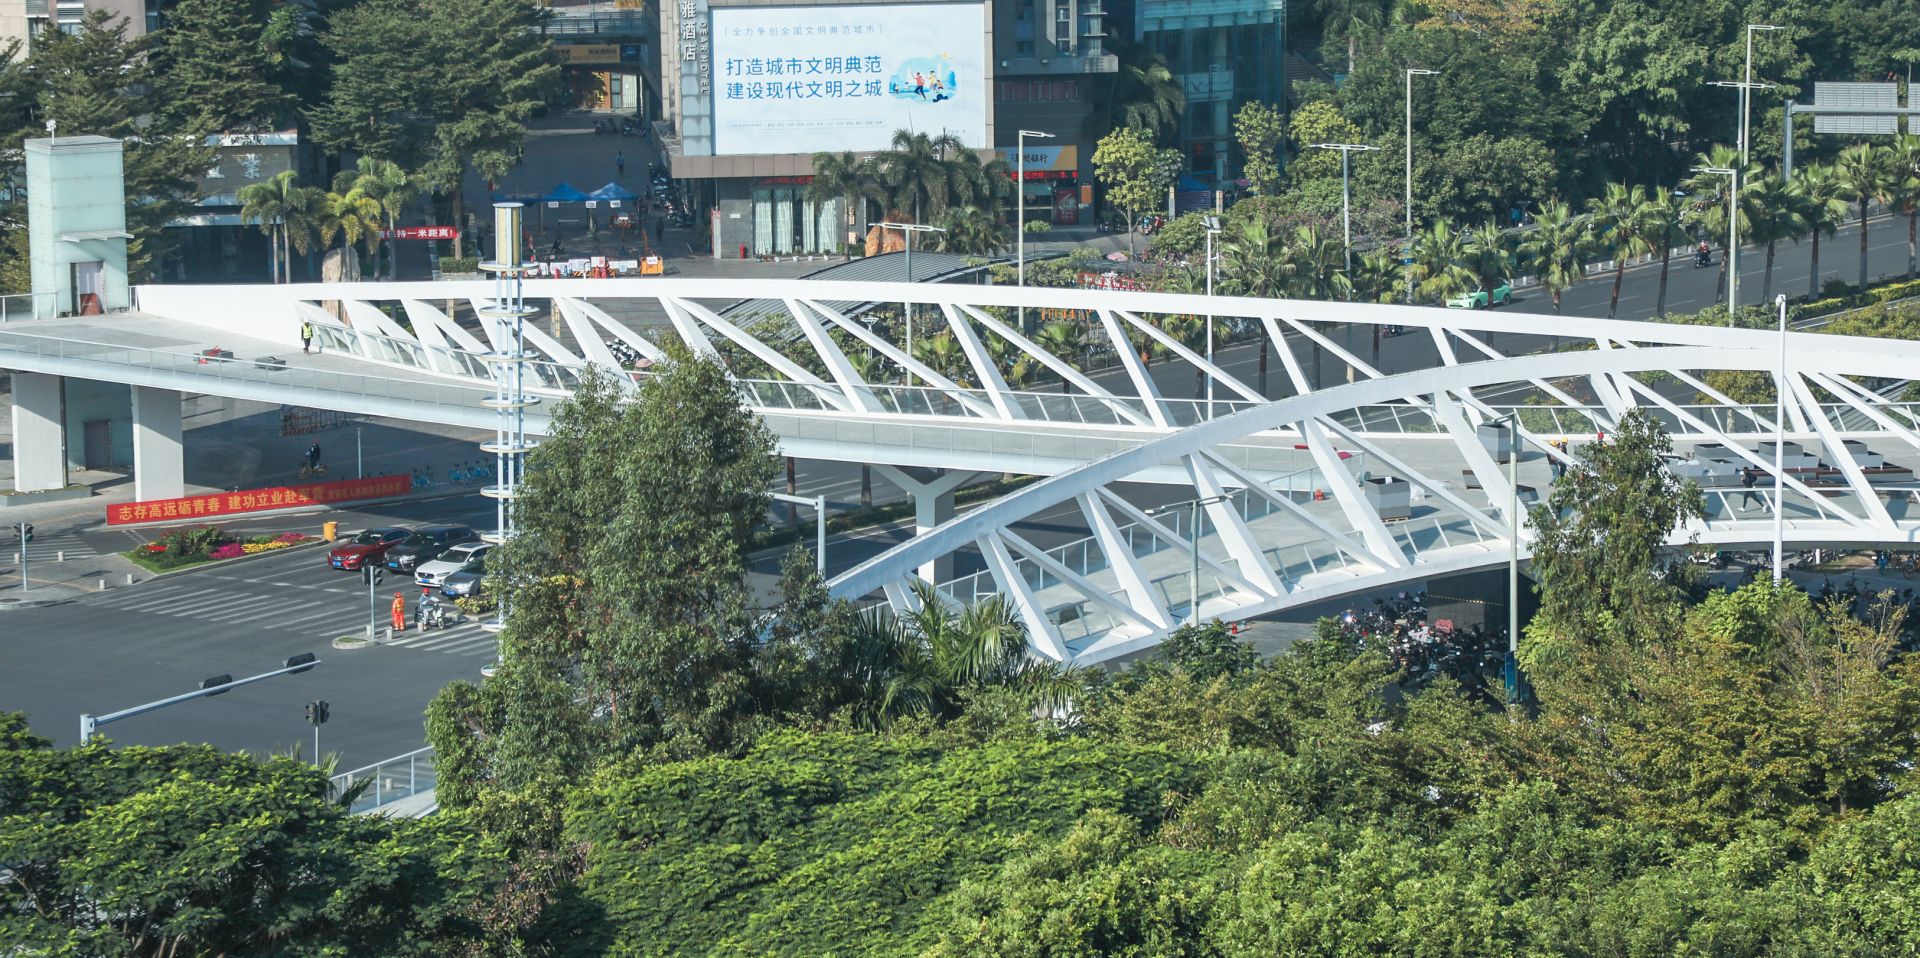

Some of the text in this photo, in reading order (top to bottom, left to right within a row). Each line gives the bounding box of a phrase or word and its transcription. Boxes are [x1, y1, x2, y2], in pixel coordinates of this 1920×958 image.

[681, 0, 697, 61] 雅酒店
[699, 22, 710, 94] DEAR HOTEL
[726, 56, 882, 76] 打造城市文明典范
[726, 79, 882, 100] 建设现代文明之城
[119, 501, 220, 521] 志存高远砺青春
[228, 486, 325, 510] 建功立业赴军营
